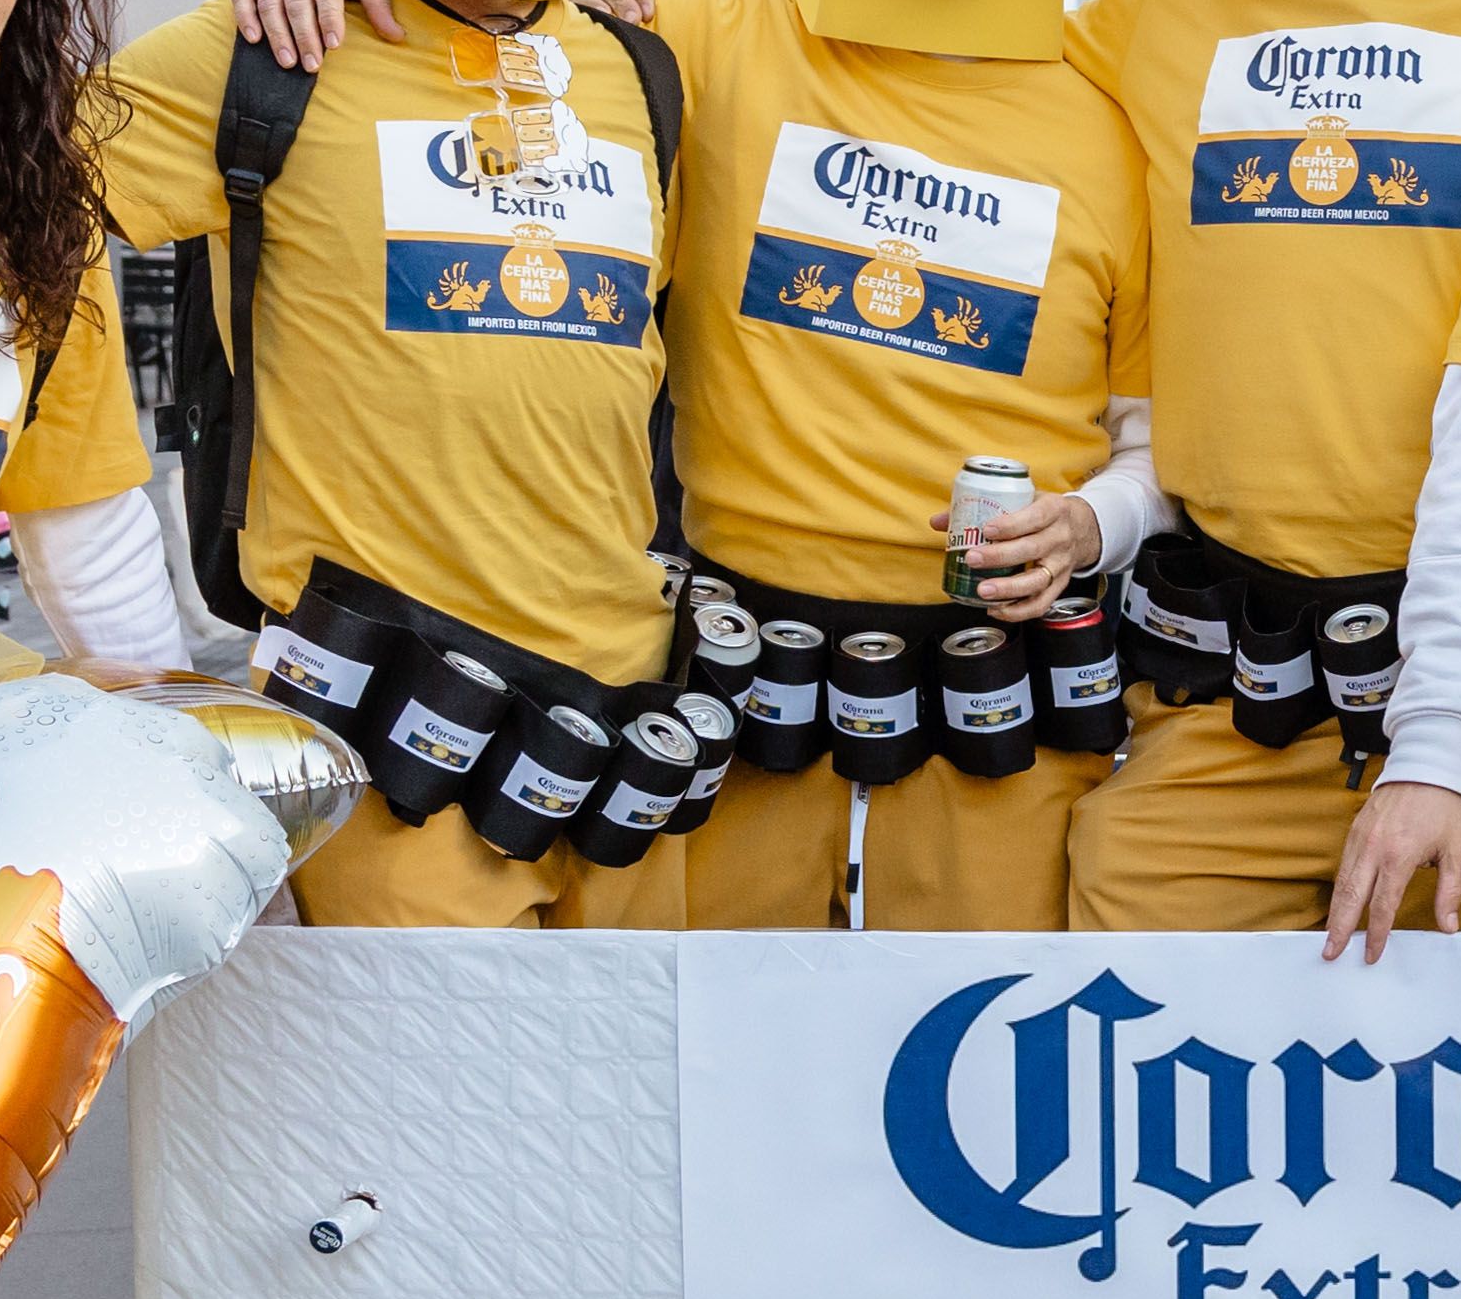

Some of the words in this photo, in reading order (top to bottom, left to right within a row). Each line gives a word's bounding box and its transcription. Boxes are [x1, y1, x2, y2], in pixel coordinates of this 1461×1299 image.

[1246, 35, 1424, 97] Corona
[1290, 84, 1362, 110] Extra
[1315, 145, 1333, 156] LA
[1291, 156, 1356, 168] CERVEZA
[1307, 168, 1338, 180] MAS
[813, 142, 1002, 227] Corona
[1306, 179, 1338, 192] FINA
[490, 186, 567, 220] Extra
[862, 200, 939, 243] Extra
[1254, 207, 1300, 218] IMPORTED
[1301, 208, 1325, 219] BEER
[1326, 208, 1353, 220] FROM
[1354, 209, 1390, 221] MEXICO
[525, 253, 544, 266] LA
[503, 264, 567, 282] CERVEZA
[881, 267, 902, 282] LA
[520, 277, 551, 290] MAS
[857, 275, 922, 299] CERVEZA
[520, 290, 552, 305] FINA
[871, 289, 904, 307] MAS
[867, 302, 901, 319] FINA
[468, 316, 516, 329] IMPORTED
[517, 318, 540, 331] BEER
[542, 320, 566, 334] FROM
[567, 322, 598, 337] MEXICO
[811, 315, 859, 336] IMPORTED
[859, 325, 883, 342] BEER
[884, 331, 912, 348] FROM
[912, 337, 948, 357] MEXICO
[287, 644, 326, 671] Corona
[1345, 675, 1391, 691] Corona
[842, 702, 884, 716] Corona
[969, 695, 1012, 709] Corona
[425, 722, 470, 748] Corona
